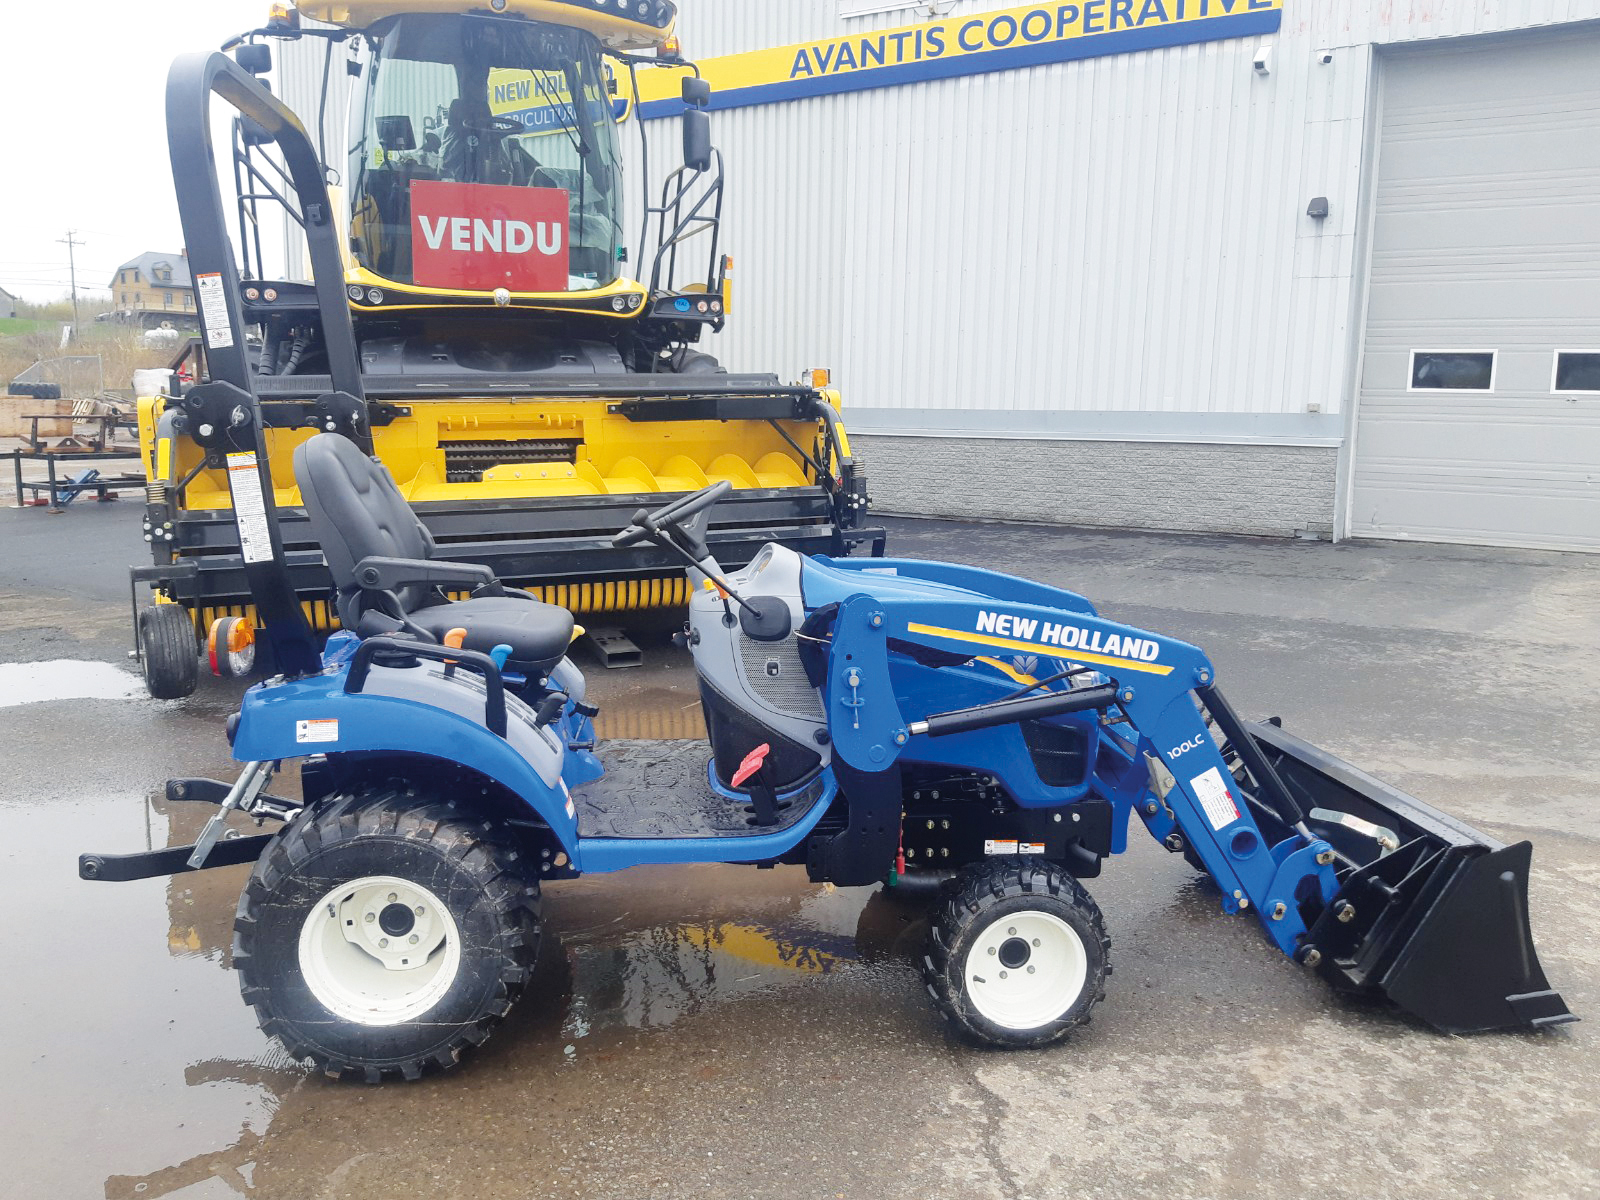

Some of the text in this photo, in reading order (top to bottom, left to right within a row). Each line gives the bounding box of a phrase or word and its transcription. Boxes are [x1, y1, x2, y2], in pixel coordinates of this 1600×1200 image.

[789, 0, 1273, 79] AVANTIS COOPERA
[495, 79, 531, 104] NEW
[418, 215, 562, 256] VENDU
[976, 610, 1160, 662] NEW HOLLAND
[1166, 733, 1205, 760] 100LC
